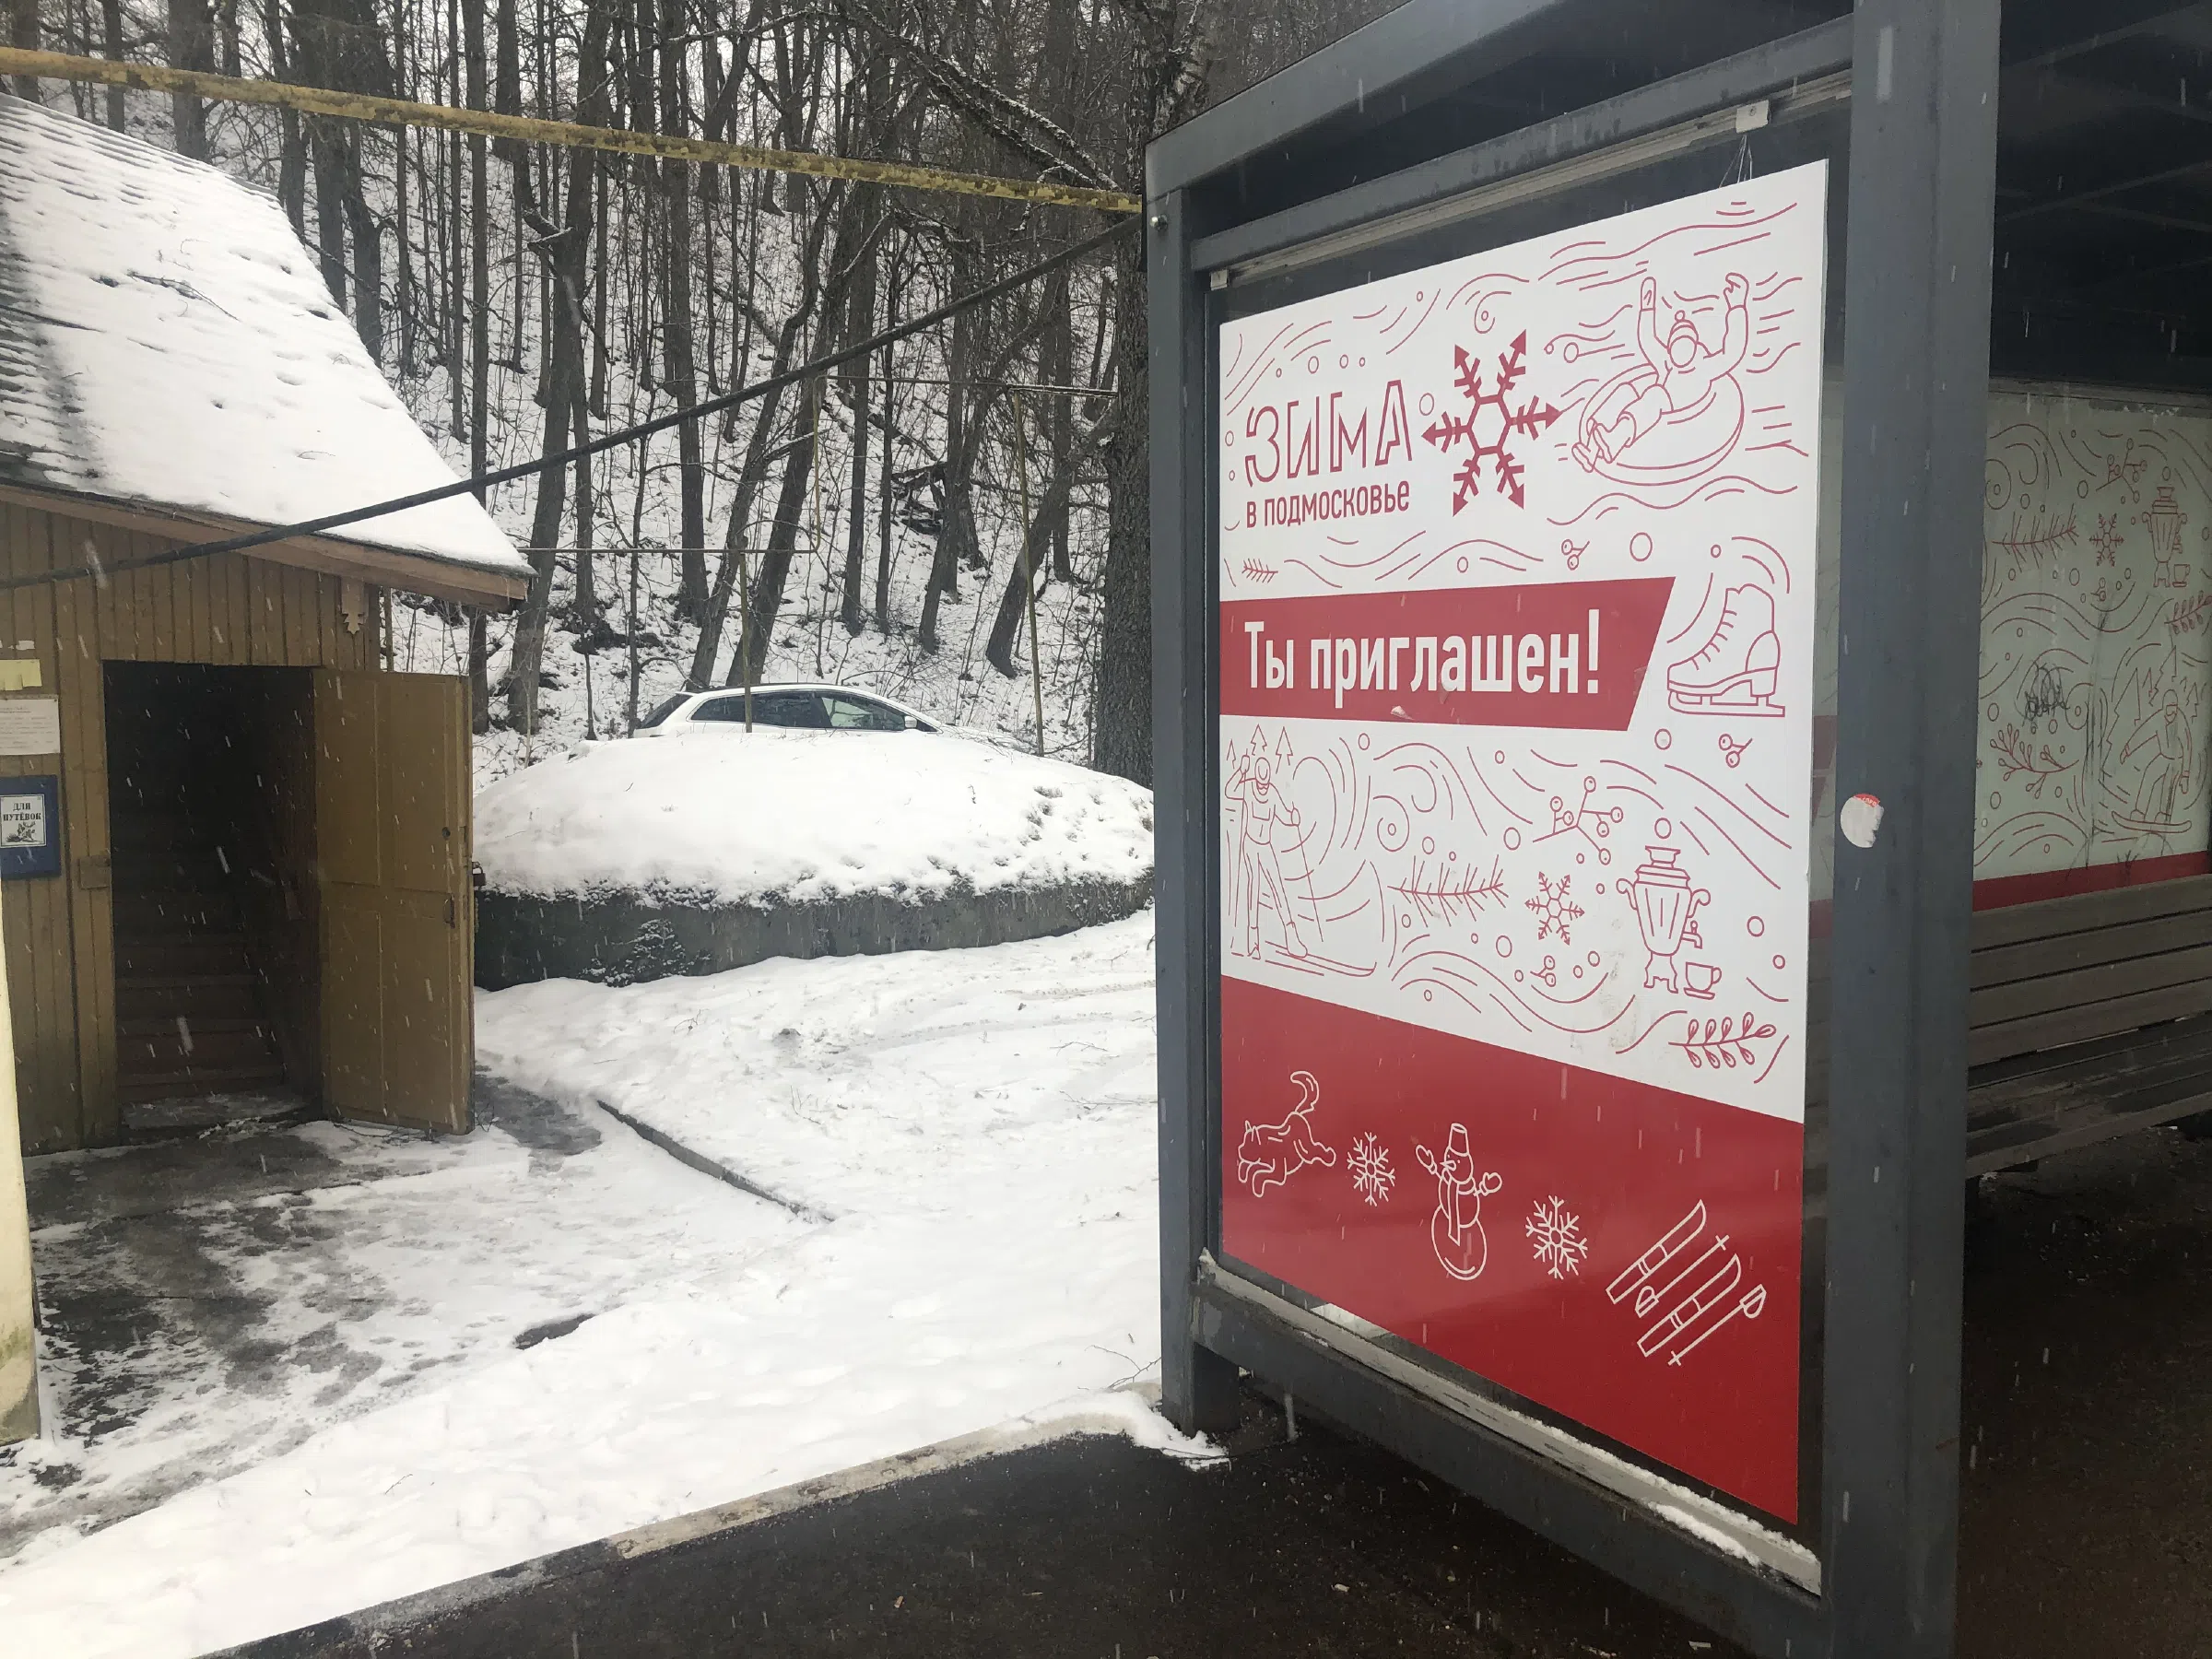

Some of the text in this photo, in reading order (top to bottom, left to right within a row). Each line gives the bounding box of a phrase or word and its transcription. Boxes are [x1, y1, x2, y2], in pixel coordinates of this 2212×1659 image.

[1244, 379, 1413, 487] ЗИМА
[1244, 608, 1600, 709] Ты приглашен!
[13, 802, 31, 811] ДЛЯ
